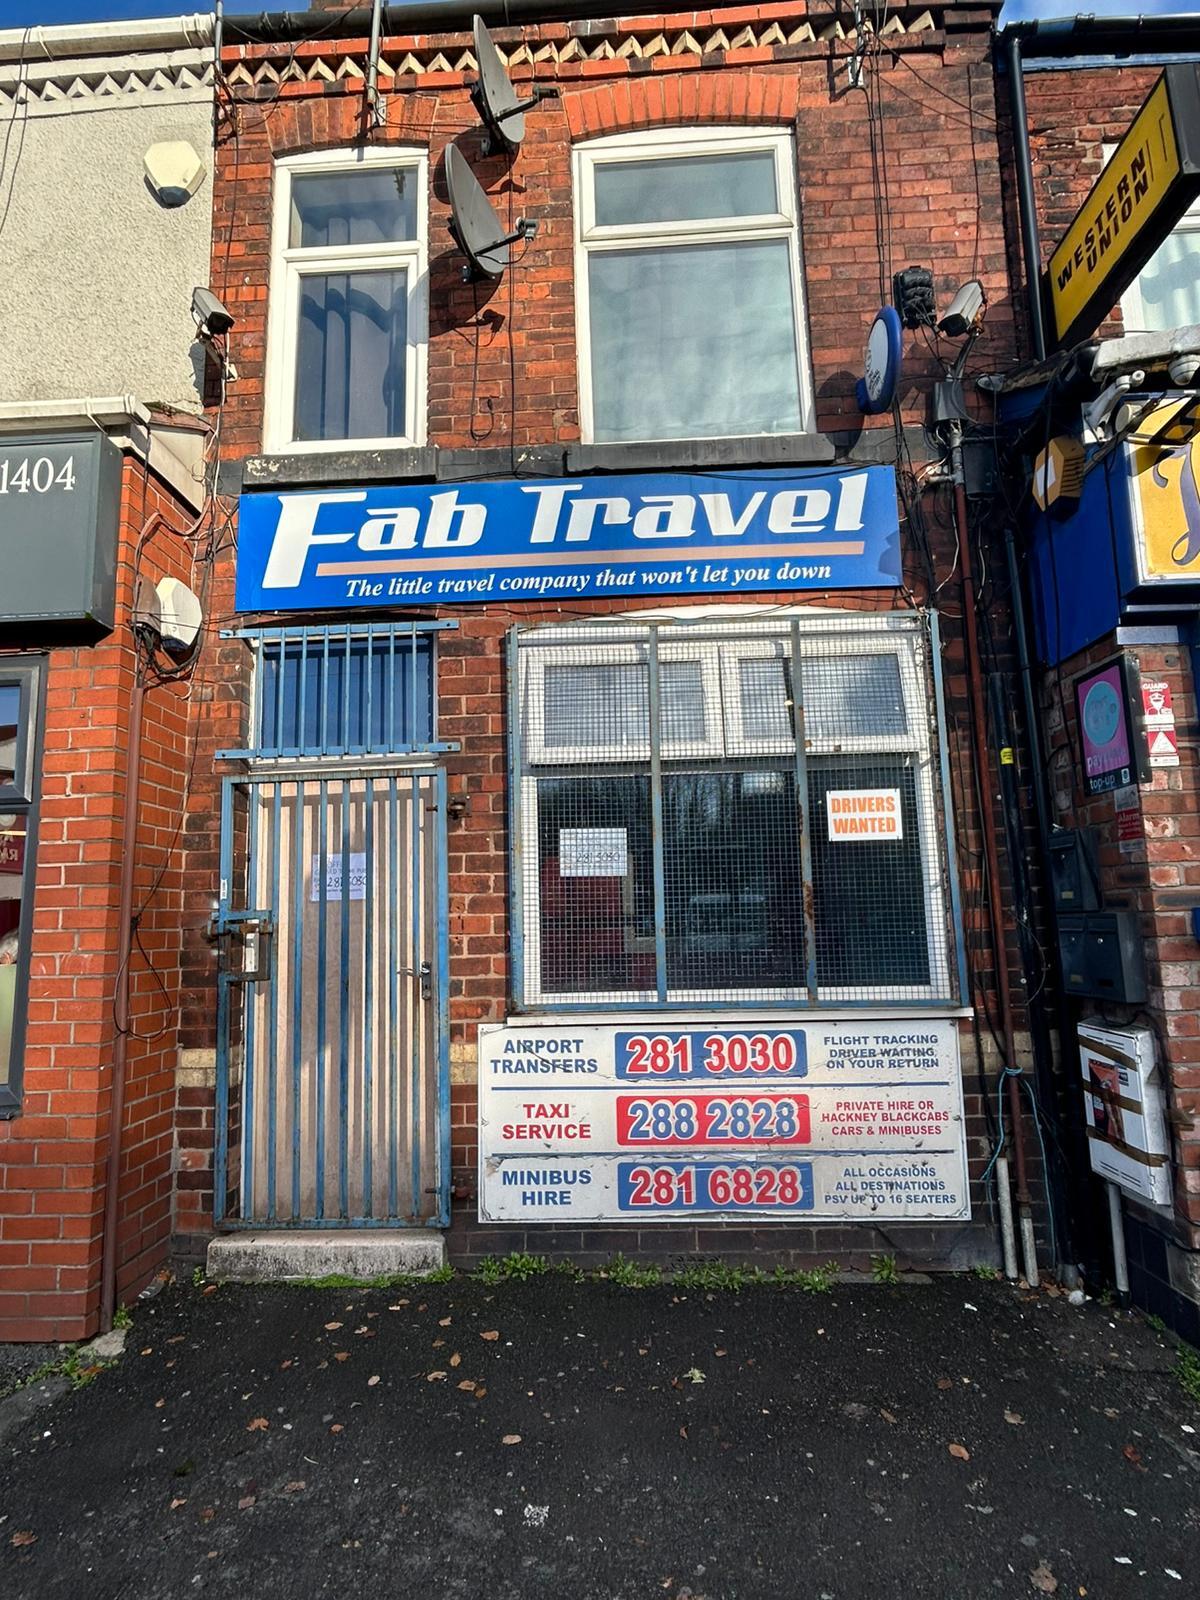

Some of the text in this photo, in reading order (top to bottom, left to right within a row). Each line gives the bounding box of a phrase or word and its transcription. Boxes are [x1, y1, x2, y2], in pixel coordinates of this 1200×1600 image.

[1057, 148, 1145, 291] WESTERN
[1086, 171, 1149, 273] UNION
[0, 456, 76, 493] 1404
[262, 473, 868, 588] Fab Travel
[346, 562, 832, 597] The little travel company that won't let you down
[1090, 775, 1116, 792] top-up
[831, 796, 896, 813] DRIVERS
[833, 817, 897, 834] WANTED
[504, 1039, 584, 1054] AIRPORT
[824, 1035, 938, 1046] FLIGHT TRACKING
[626, 1034, 796, 1074] 281 3030
[829, 1047, 935, 1058] DRIVER WAITING
[491, 1058, 598, 1074] TRANSFERS
[827, 1058, 939, 1069] ON YOUR RETURN
[523, 1103, 570, 1118] TAXI
[836, 1100, 934, 1111] PRIVATE HIRE OR
[628, 1098, 799, 1140] 288 2828
[822, 1111, 949, 1122] HACKNEY BLACKCABS
[502, 1123, 591, 1139] SERVICE
[831, 1125, 942, 1136] CARS & MINIBUSES
[502, 1169, 592, 1185] MINIBUS
[843, 1167, 936, 1177] ALL OCCASIONS
[629, 1164, 803, 1206] 281 6828
[835, 1181, 945, 1191] ALL DESTINATIONS
[522, 1190, 572, 1206] HIRE
[824, 1194, 957, 1204] PSV UP TO 16 SEATERS
